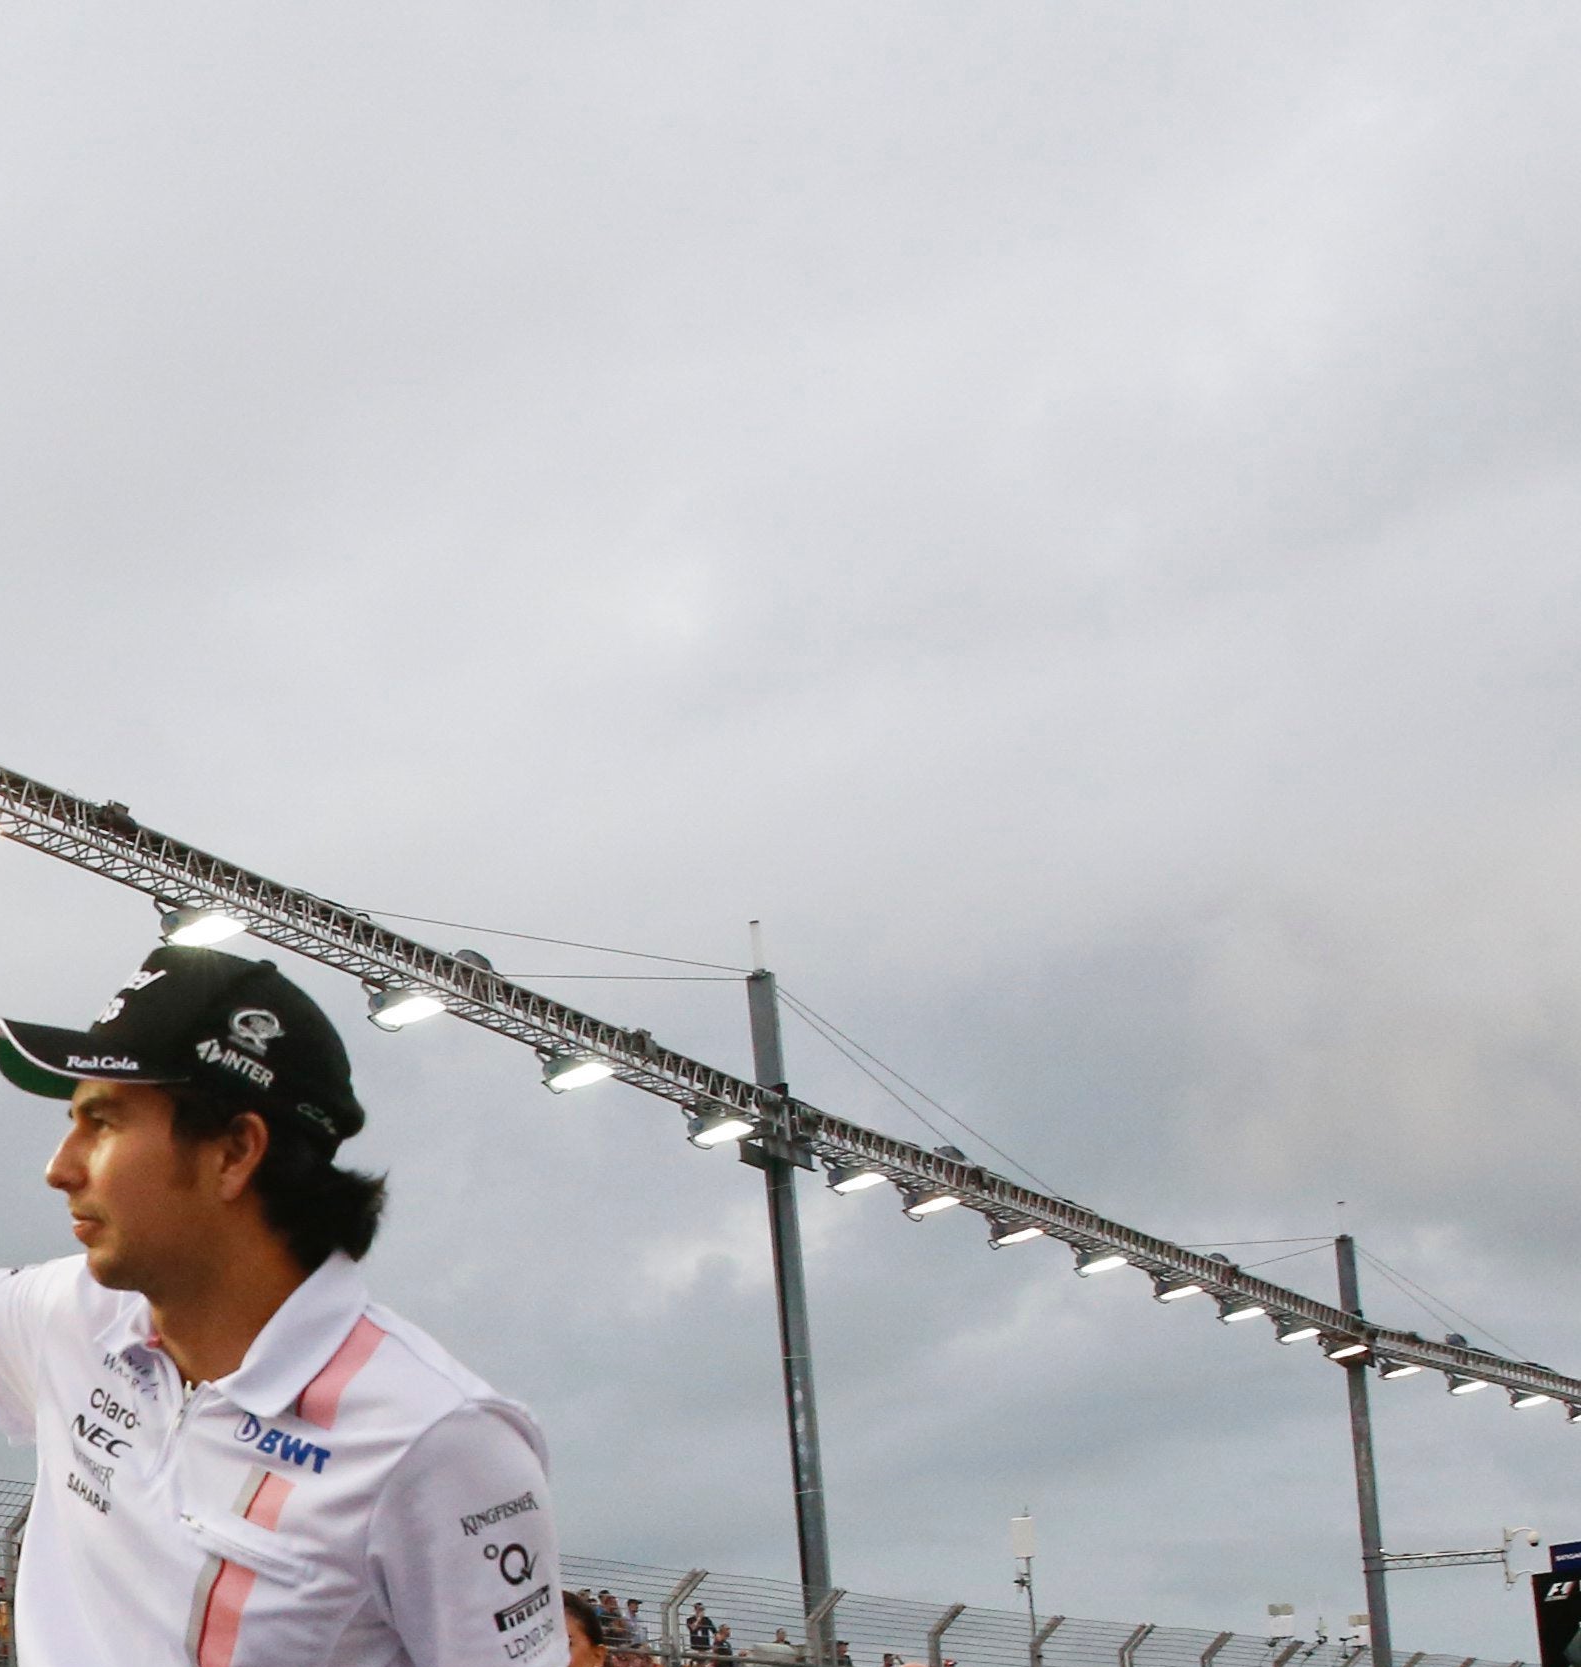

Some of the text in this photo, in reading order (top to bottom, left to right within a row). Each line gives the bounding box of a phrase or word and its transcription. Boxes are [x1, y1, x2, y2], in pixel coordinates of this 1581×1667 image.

[66, 1054, 140, 1071] Red Cola
[221, 1048, 274, 1088] INTER
[71, 1413, 133, 1459] NEC
[256, 1427, 331, 1474] BWT
[460, 1490, 539, 1537] KINGFISHER
[493, 1584, 551, 1633] PIRELLI
